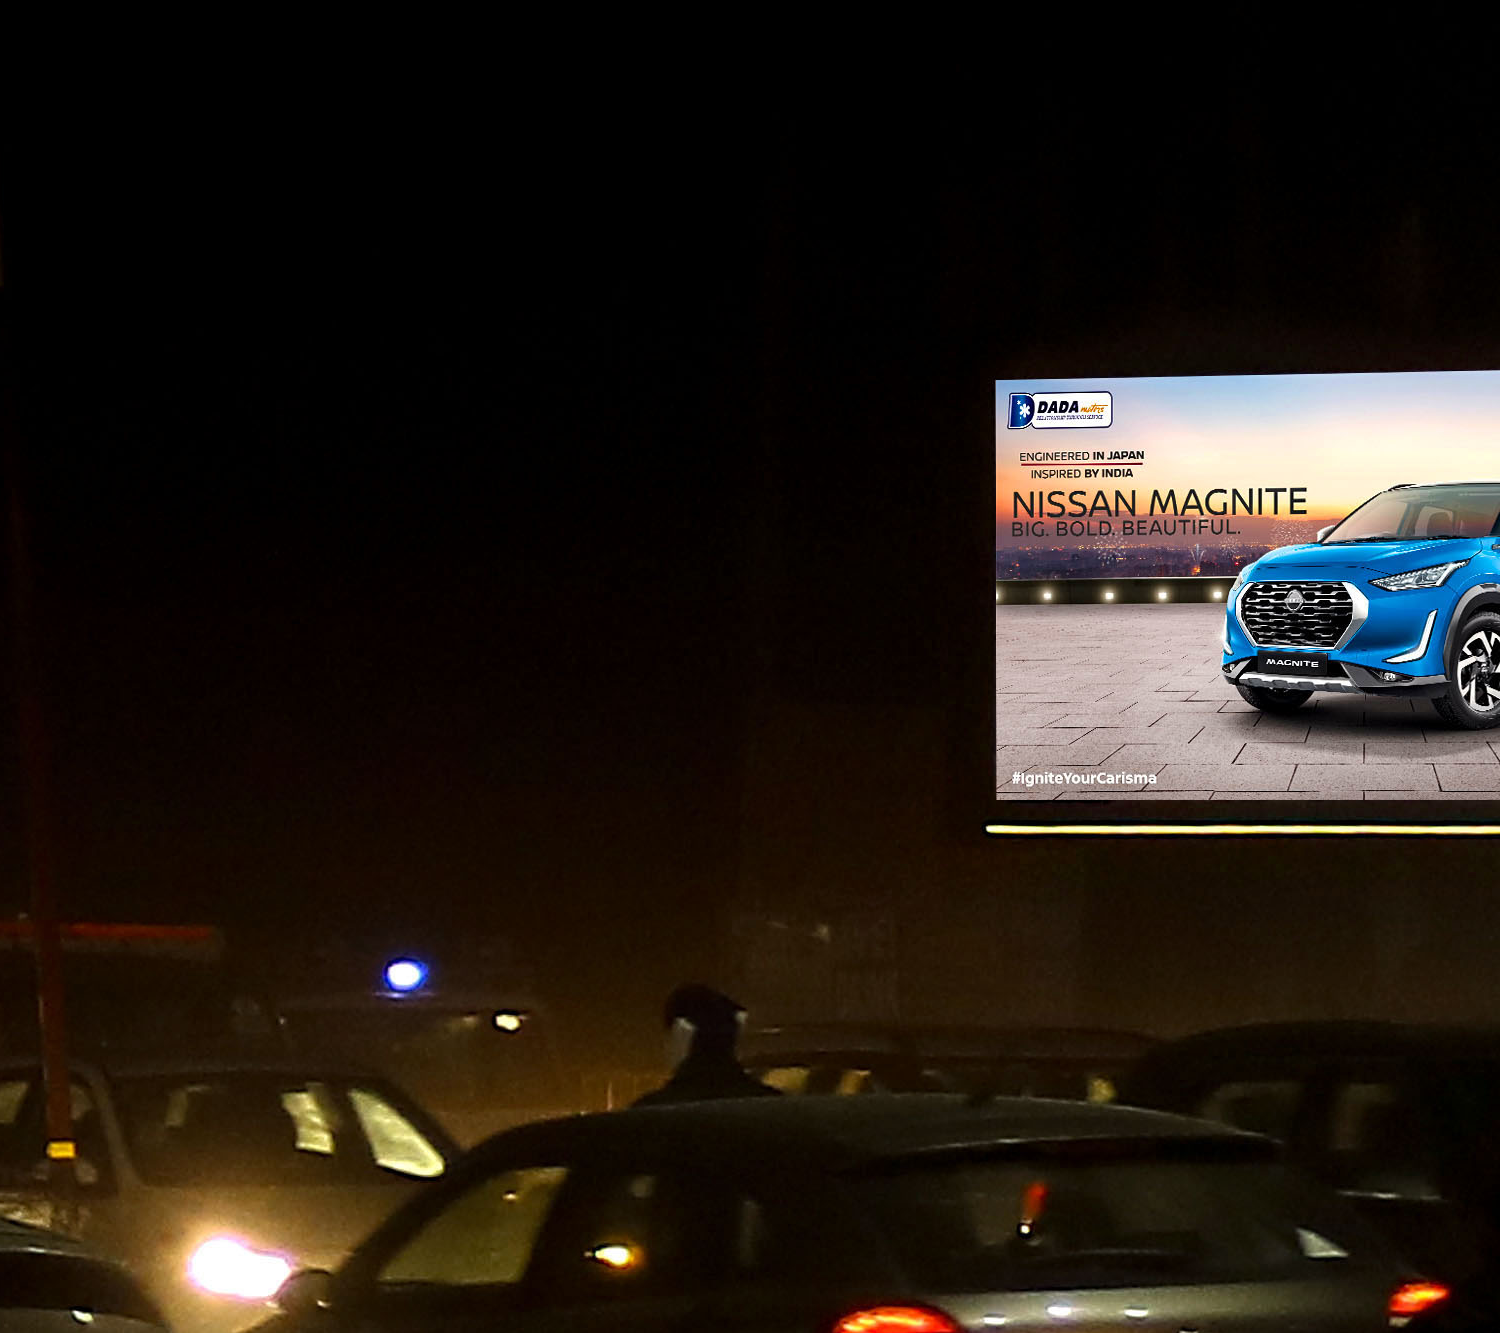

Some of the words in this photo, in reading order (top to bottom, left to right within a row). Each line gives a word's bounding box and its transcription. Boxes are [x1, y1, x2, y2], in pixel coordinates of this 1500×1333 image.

[1037, 400, 1079, 414] DADA
[1019, 451, 1090, 462] ENGINEERED
[1092, 451, 1105, 461] IN
[1107, 450, 1145, 461] JAPAN
[1030, 469, 1082, 480] INSPIRED
[1085, 469, 1100, 479] BY
[1101, 468, 1134, 478] INDIA
[1013, 489, 1137, 519] NISSAN
[1149, 487, 1308, 517] MAGNITE
[1011, 521, 1050, 538] BIG.
[1056, 521, 1115, 537] BOLD.
[1122, 519, 1242, 536] BEAUTIFUL.
[1266, 659, 1319, 668] MAGNITE
[1011, 771, 1158, 785] #IgniteYourCarisma
